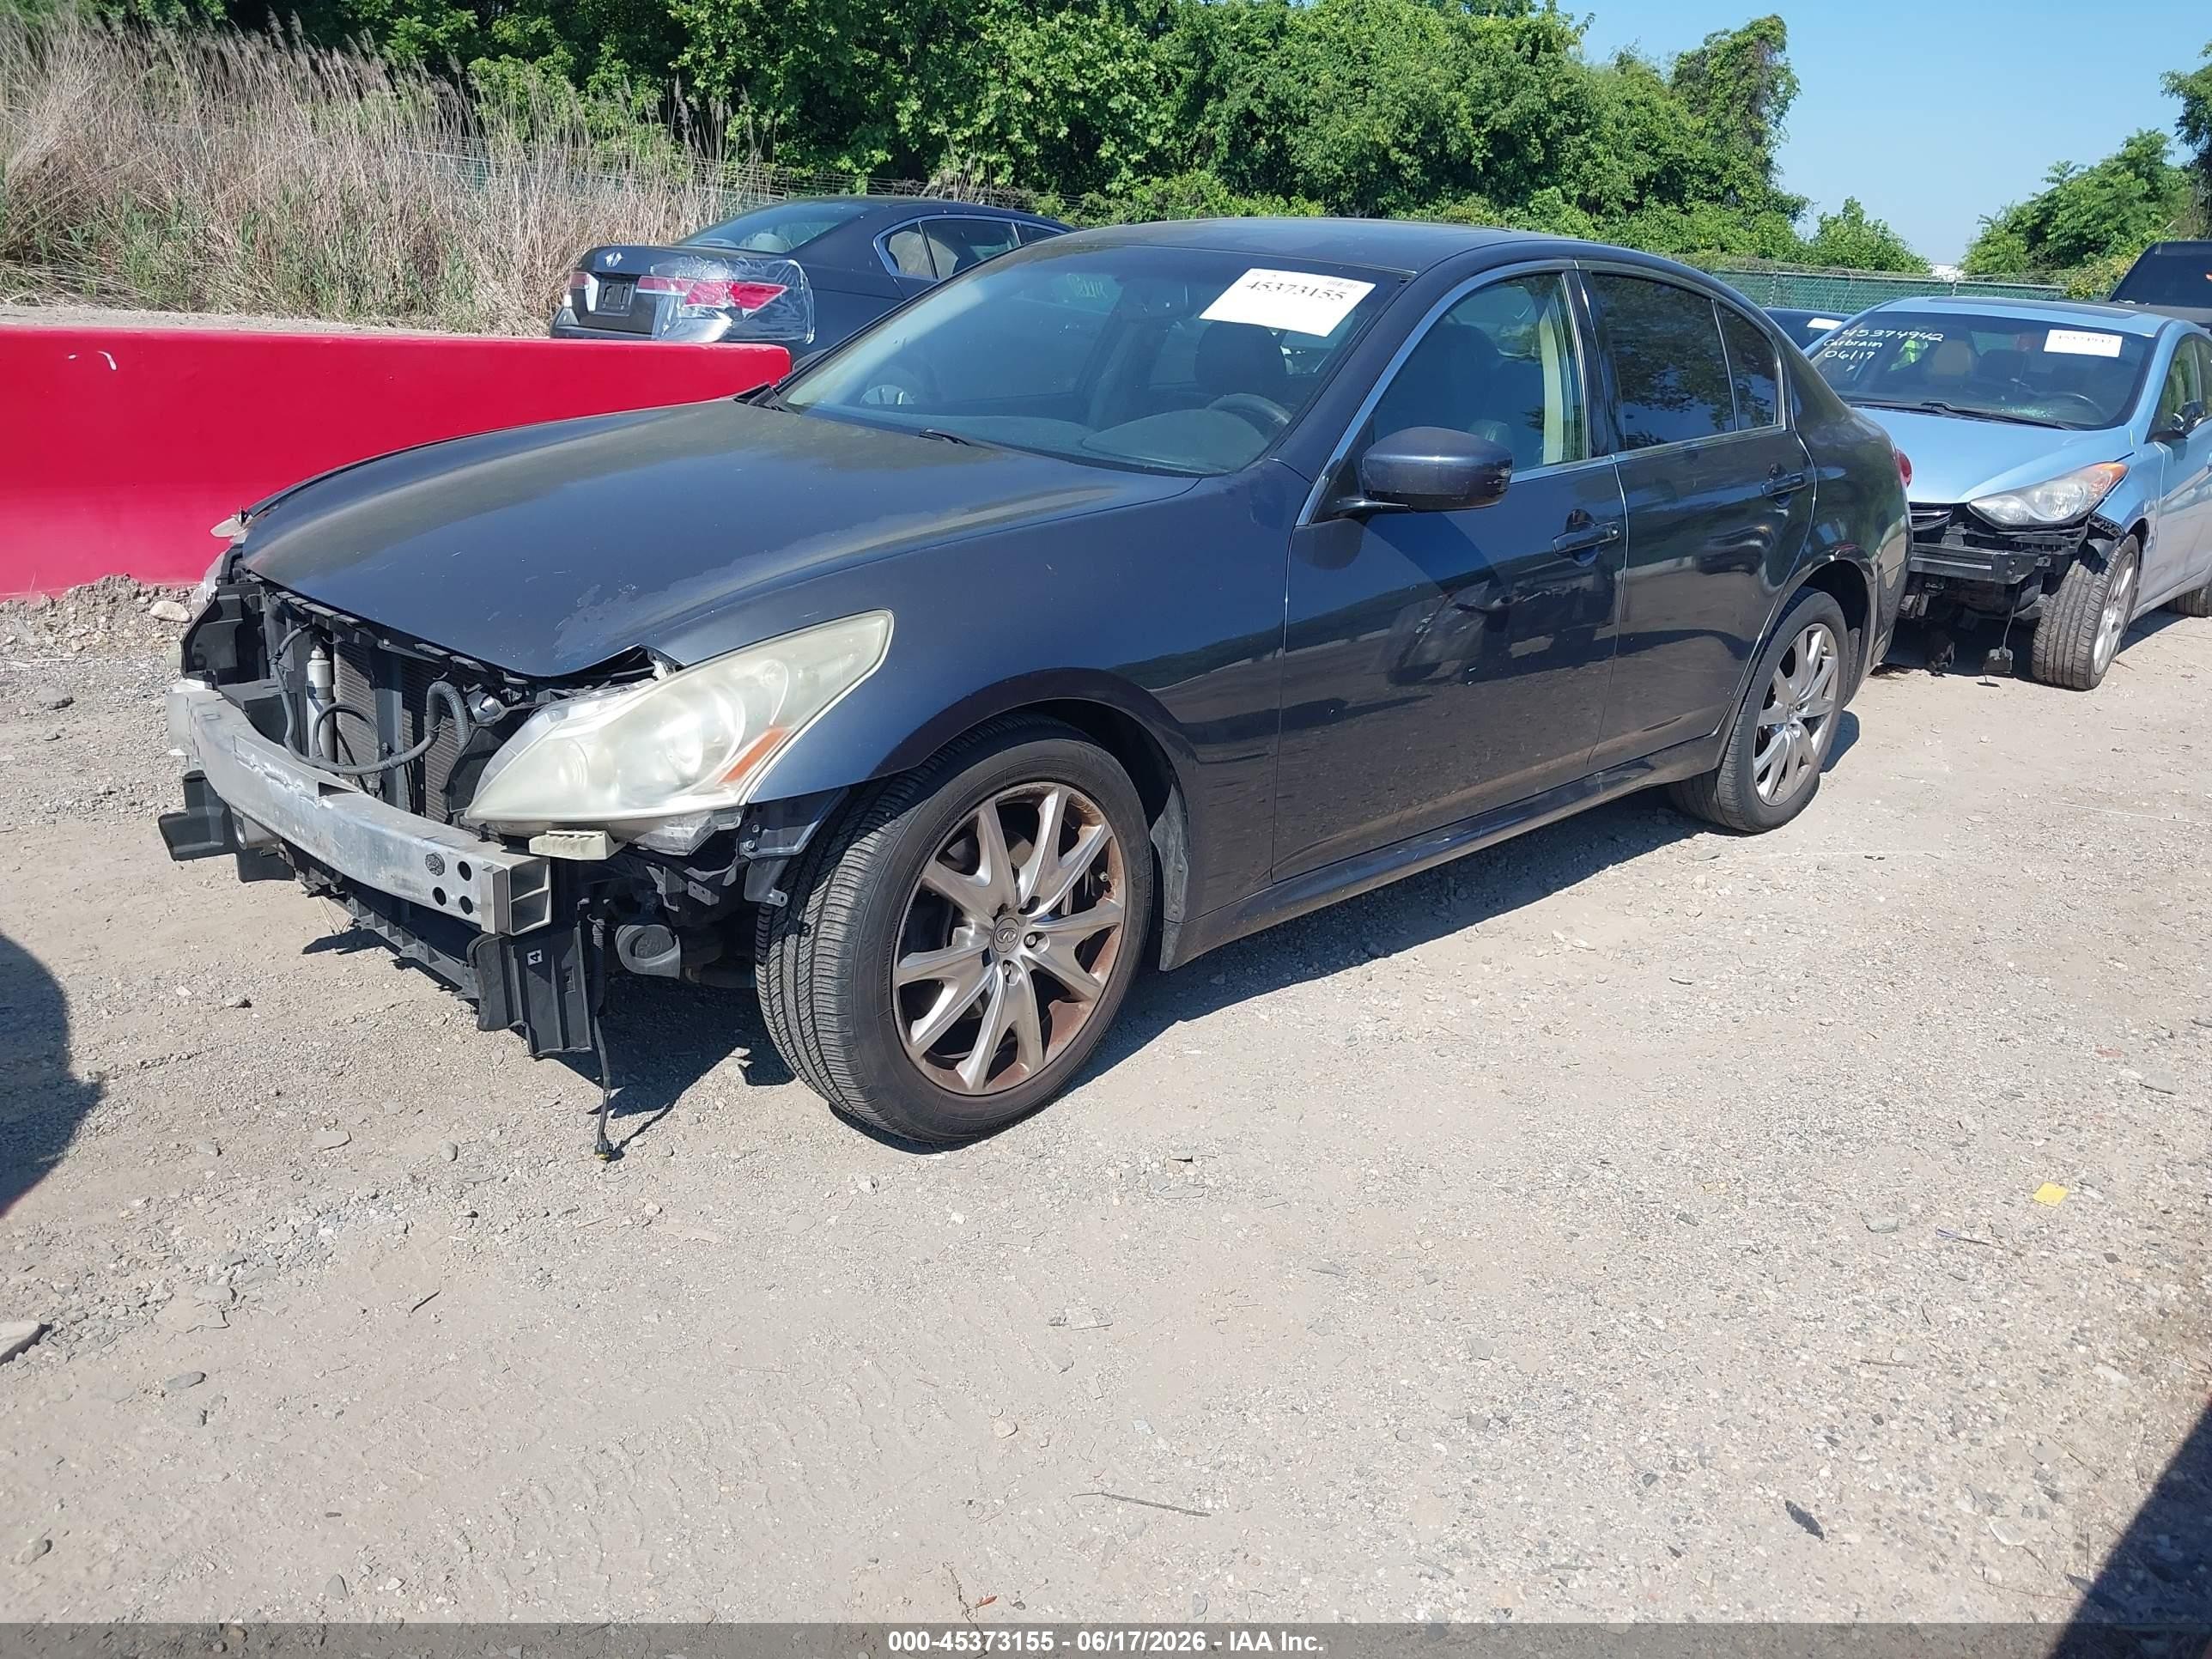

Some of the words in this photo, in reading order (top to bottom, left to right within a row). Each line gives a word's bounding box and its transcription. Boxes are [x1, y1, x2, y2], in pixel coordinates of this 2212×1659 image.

[1245, 281, 1347, 301] 45373155
[1841, 329, 1944, 342] 45374942
[1824, 349, 1875, 361] 06/17
